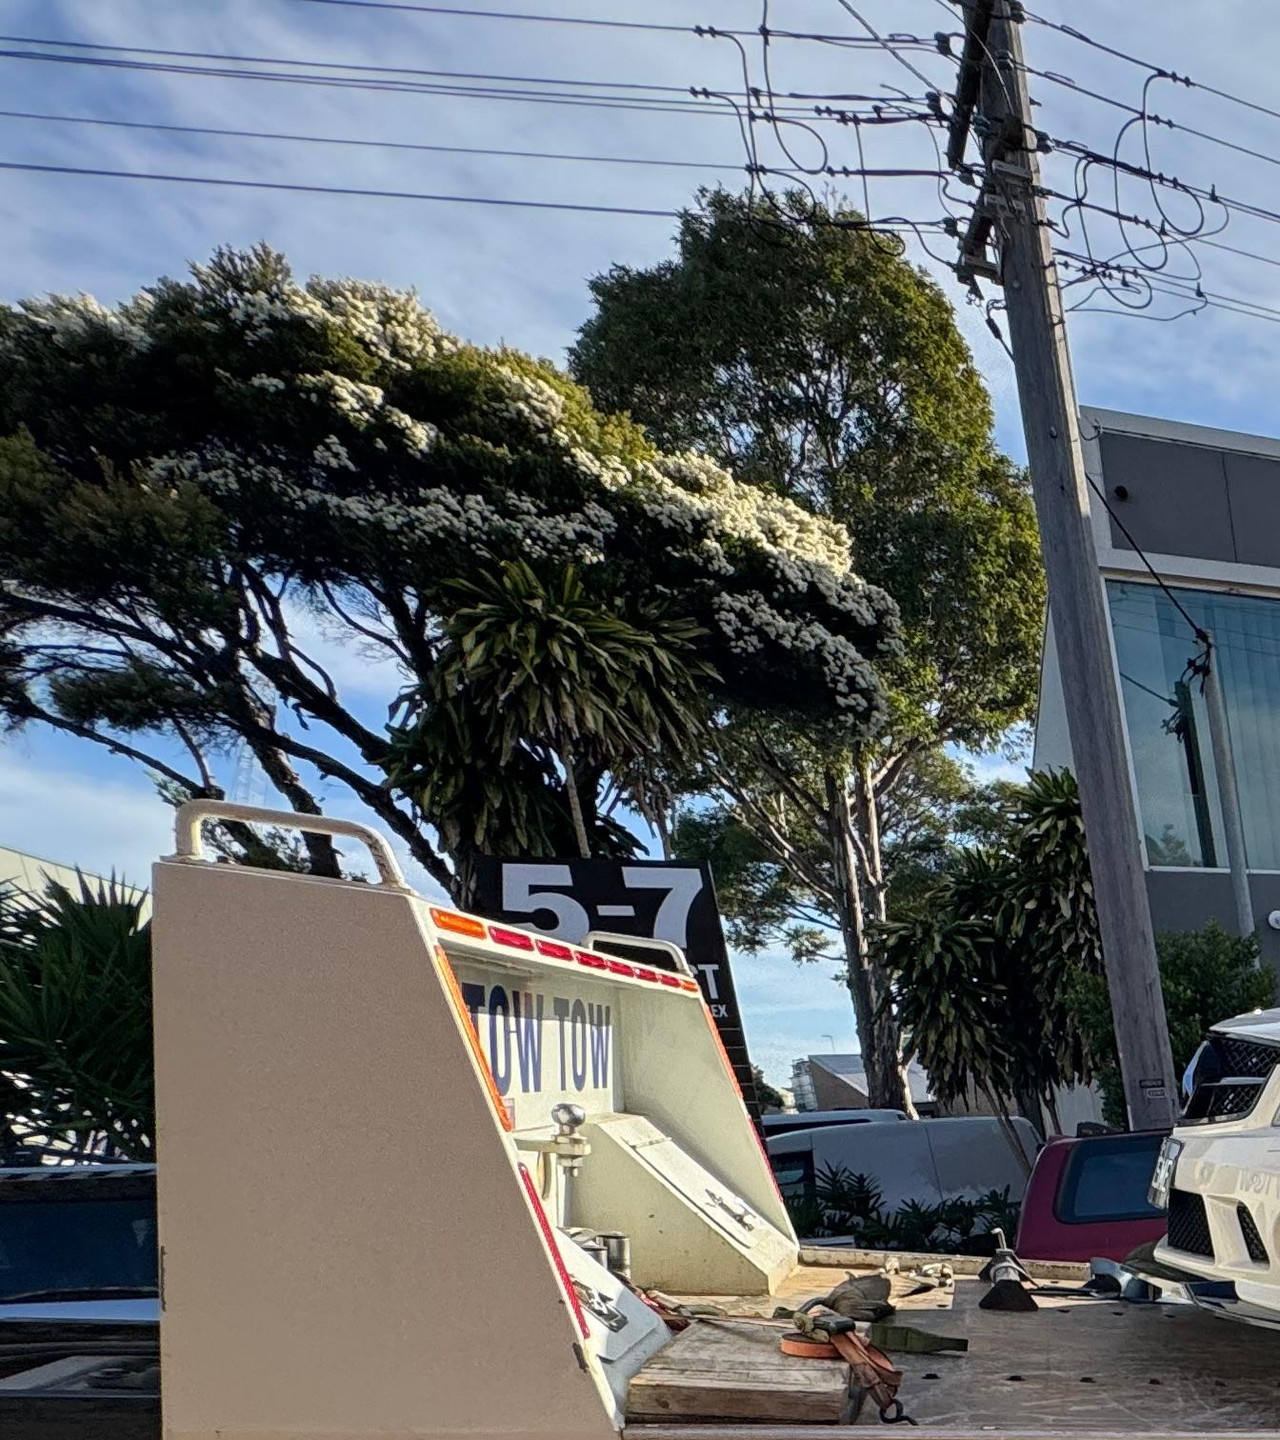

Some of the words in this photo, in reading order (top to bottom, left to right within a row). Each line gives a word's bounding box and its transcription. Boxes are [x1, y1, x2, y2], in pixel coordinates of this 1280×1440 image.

[501, 863, 703, 949] 5-7
[462, 983, 544, 1097] TOW
[553, 996, 611, 1092] TOW
